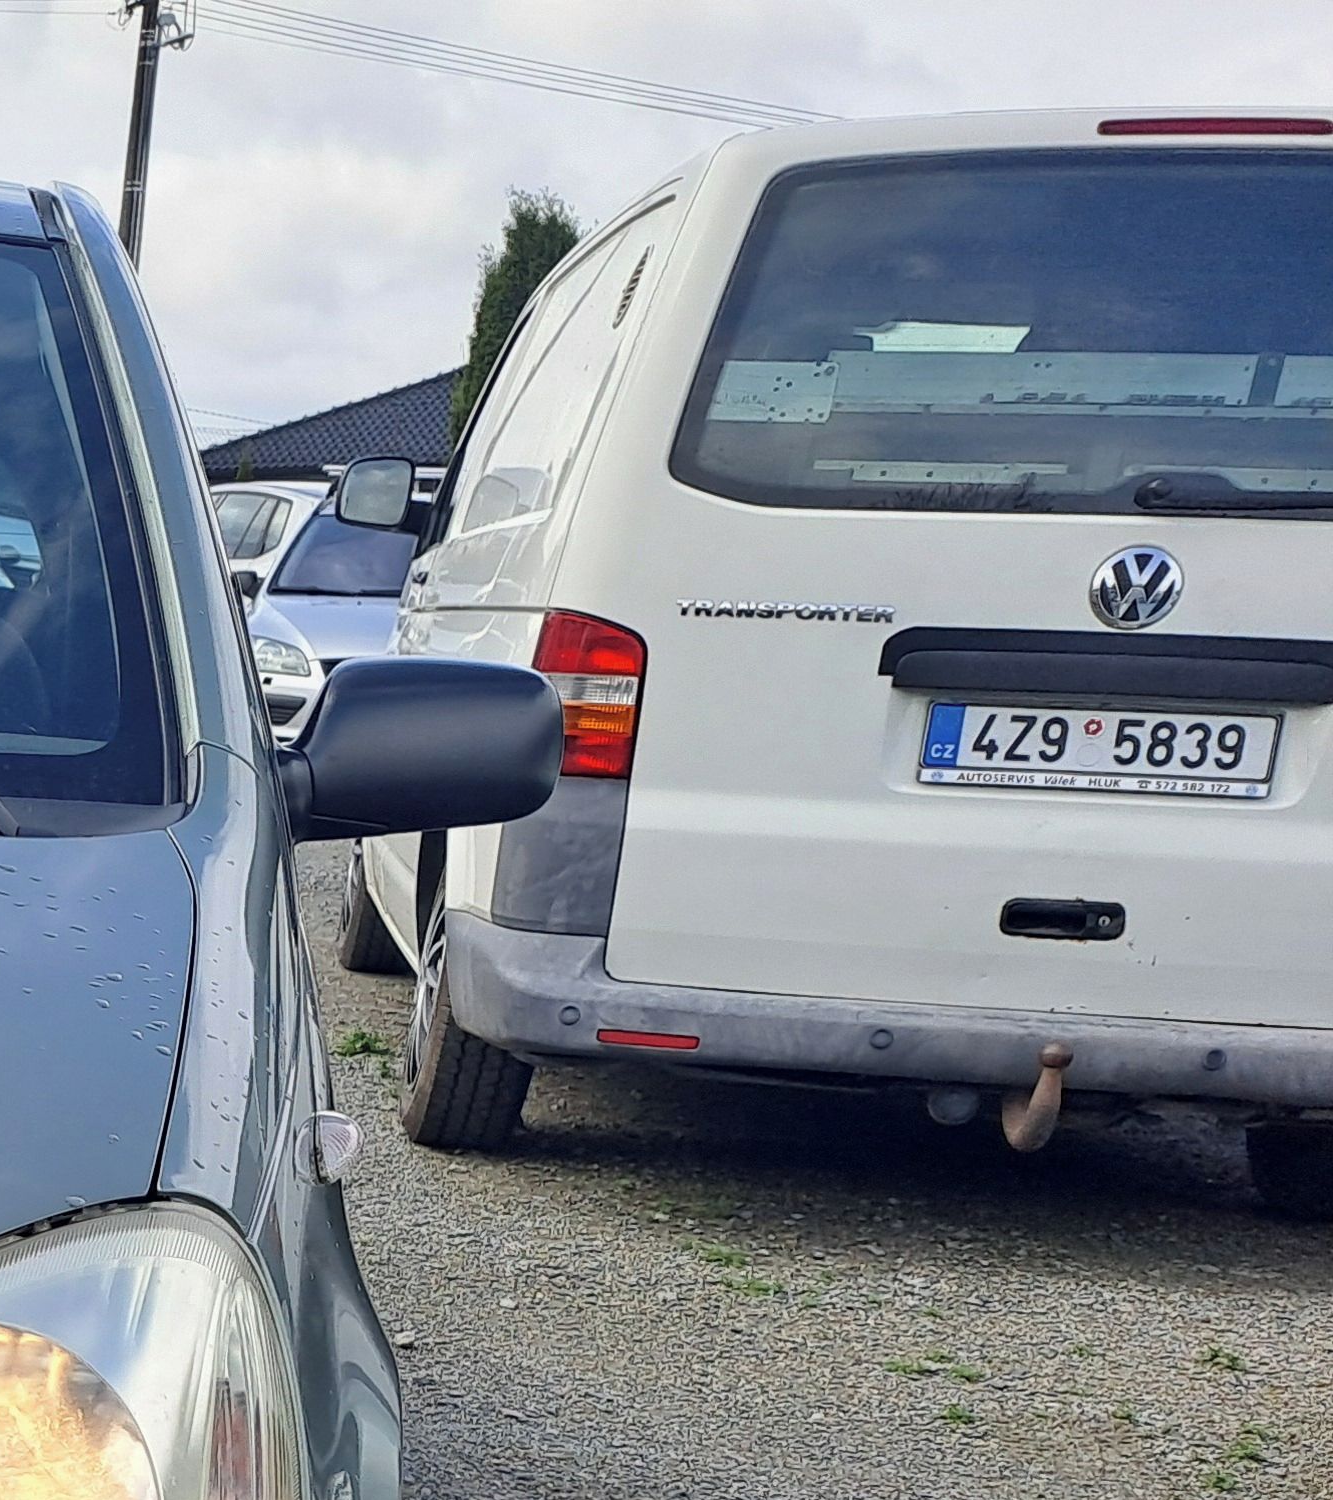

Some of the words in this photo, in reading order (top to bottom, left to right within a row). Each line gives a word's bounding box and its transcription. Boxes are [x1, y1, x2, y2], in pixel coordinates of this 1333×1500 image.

[676, 598, 896, 624] TRANSPORTER
[930, 743, 955, 759] CZ
[972, 714, 1070, 763] 4Z9
[1112, 718, 1247, 771] 5839
[956, 772, 1036, 785] AUTOSERVIS
[1088, 778, 1121, 789] HLUK
[1210, 782, 1231, 794] 172
